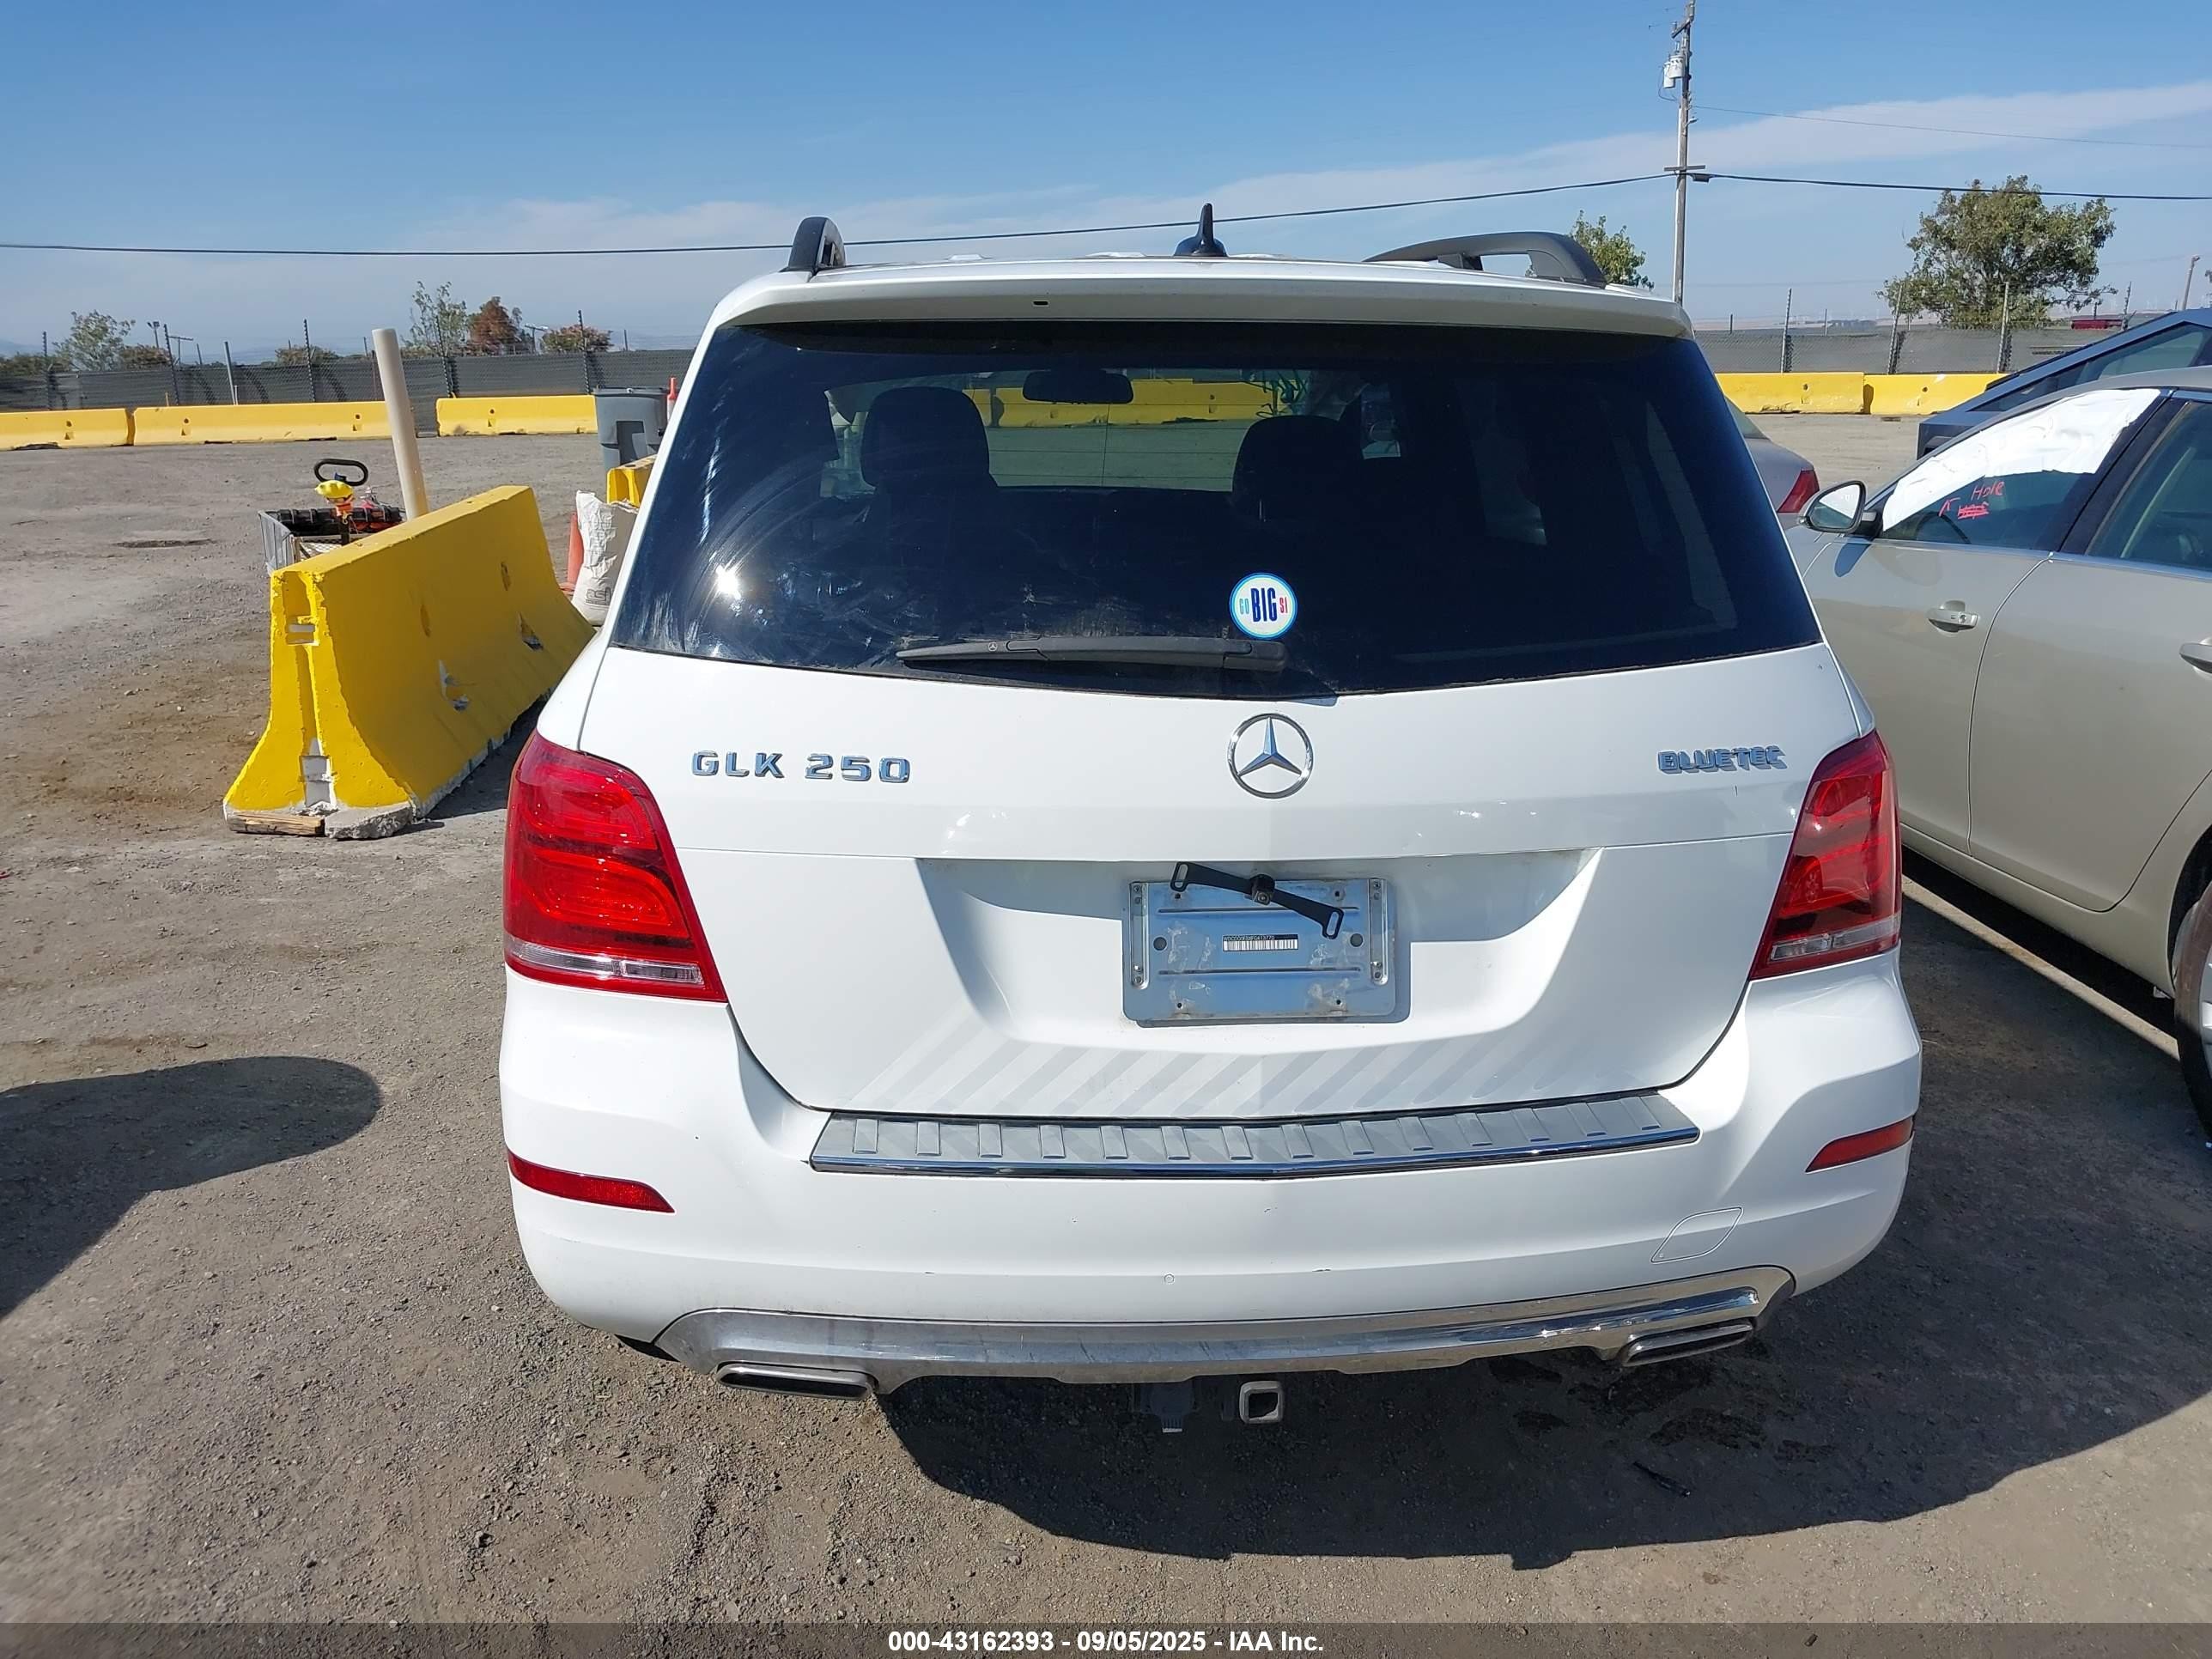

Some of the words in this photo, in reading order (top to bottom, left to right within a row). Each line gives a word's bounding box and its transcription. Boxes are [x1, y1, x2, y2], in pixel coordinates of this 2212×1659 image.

[1250, 587, 1278, 623] BIG
[691, 750, 785, 779] GLK
[805, 753, 910, 783] 250
[1658, 744, 1788, 774] BLUETEC
